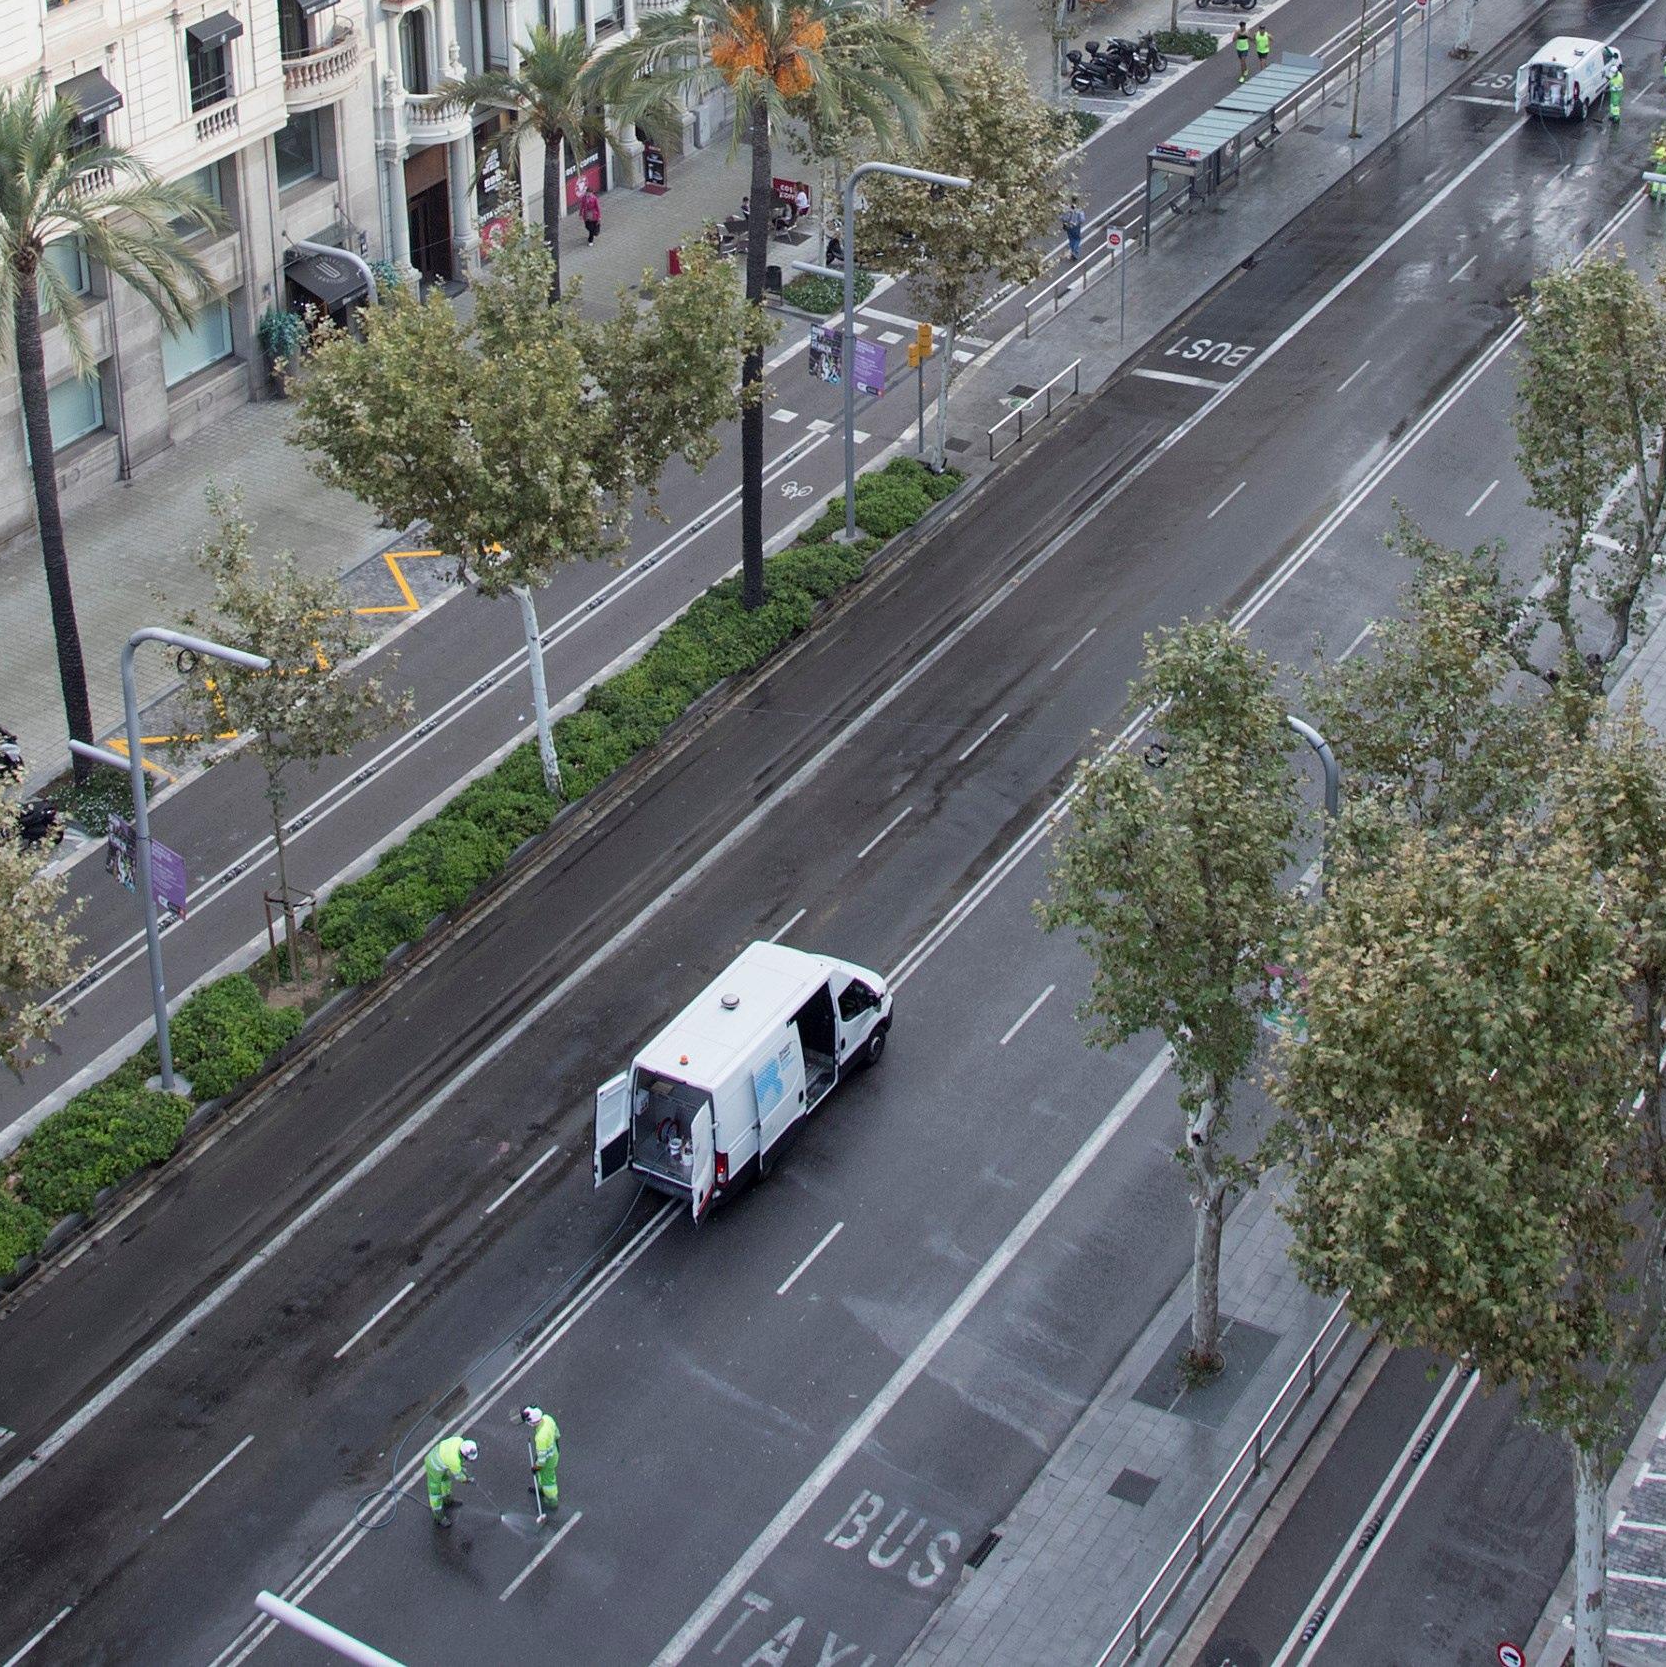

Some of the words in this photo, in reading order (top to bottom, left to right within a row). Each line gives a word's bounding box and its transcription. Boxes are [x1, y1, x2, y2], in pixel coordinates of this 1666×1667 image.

[1164, 335, 1256, 367] BUS1
[824, 1488, 962, 1588] BUS
[712, 1591, 879, 1667] TAX
